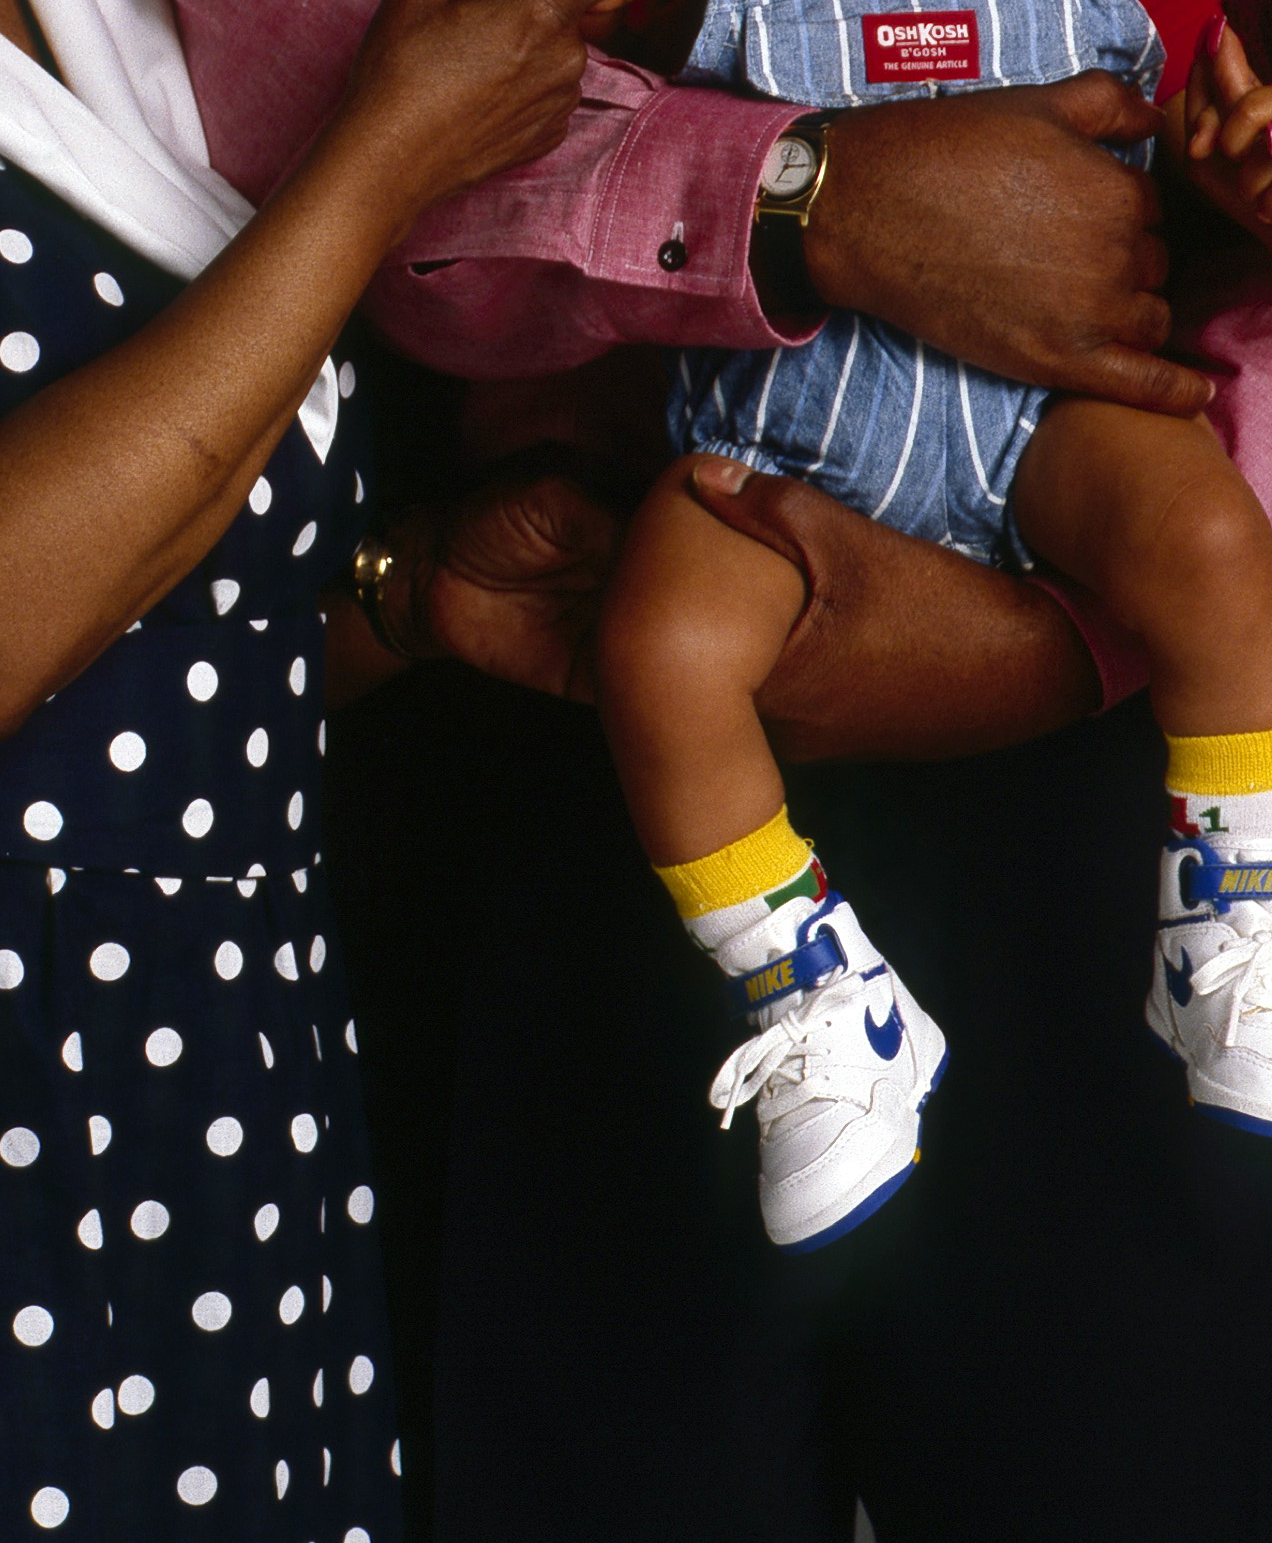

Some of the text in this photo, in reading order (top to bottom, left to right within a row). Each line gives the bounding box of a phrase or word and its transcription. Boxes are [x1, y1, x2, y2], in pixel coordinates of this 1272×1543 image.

[901, 47, 947, 58] B'GOSH
[884, 59, 968, 71] THE GENUINE ARTICLE
[745, 958, 795, 1003] NIKE
